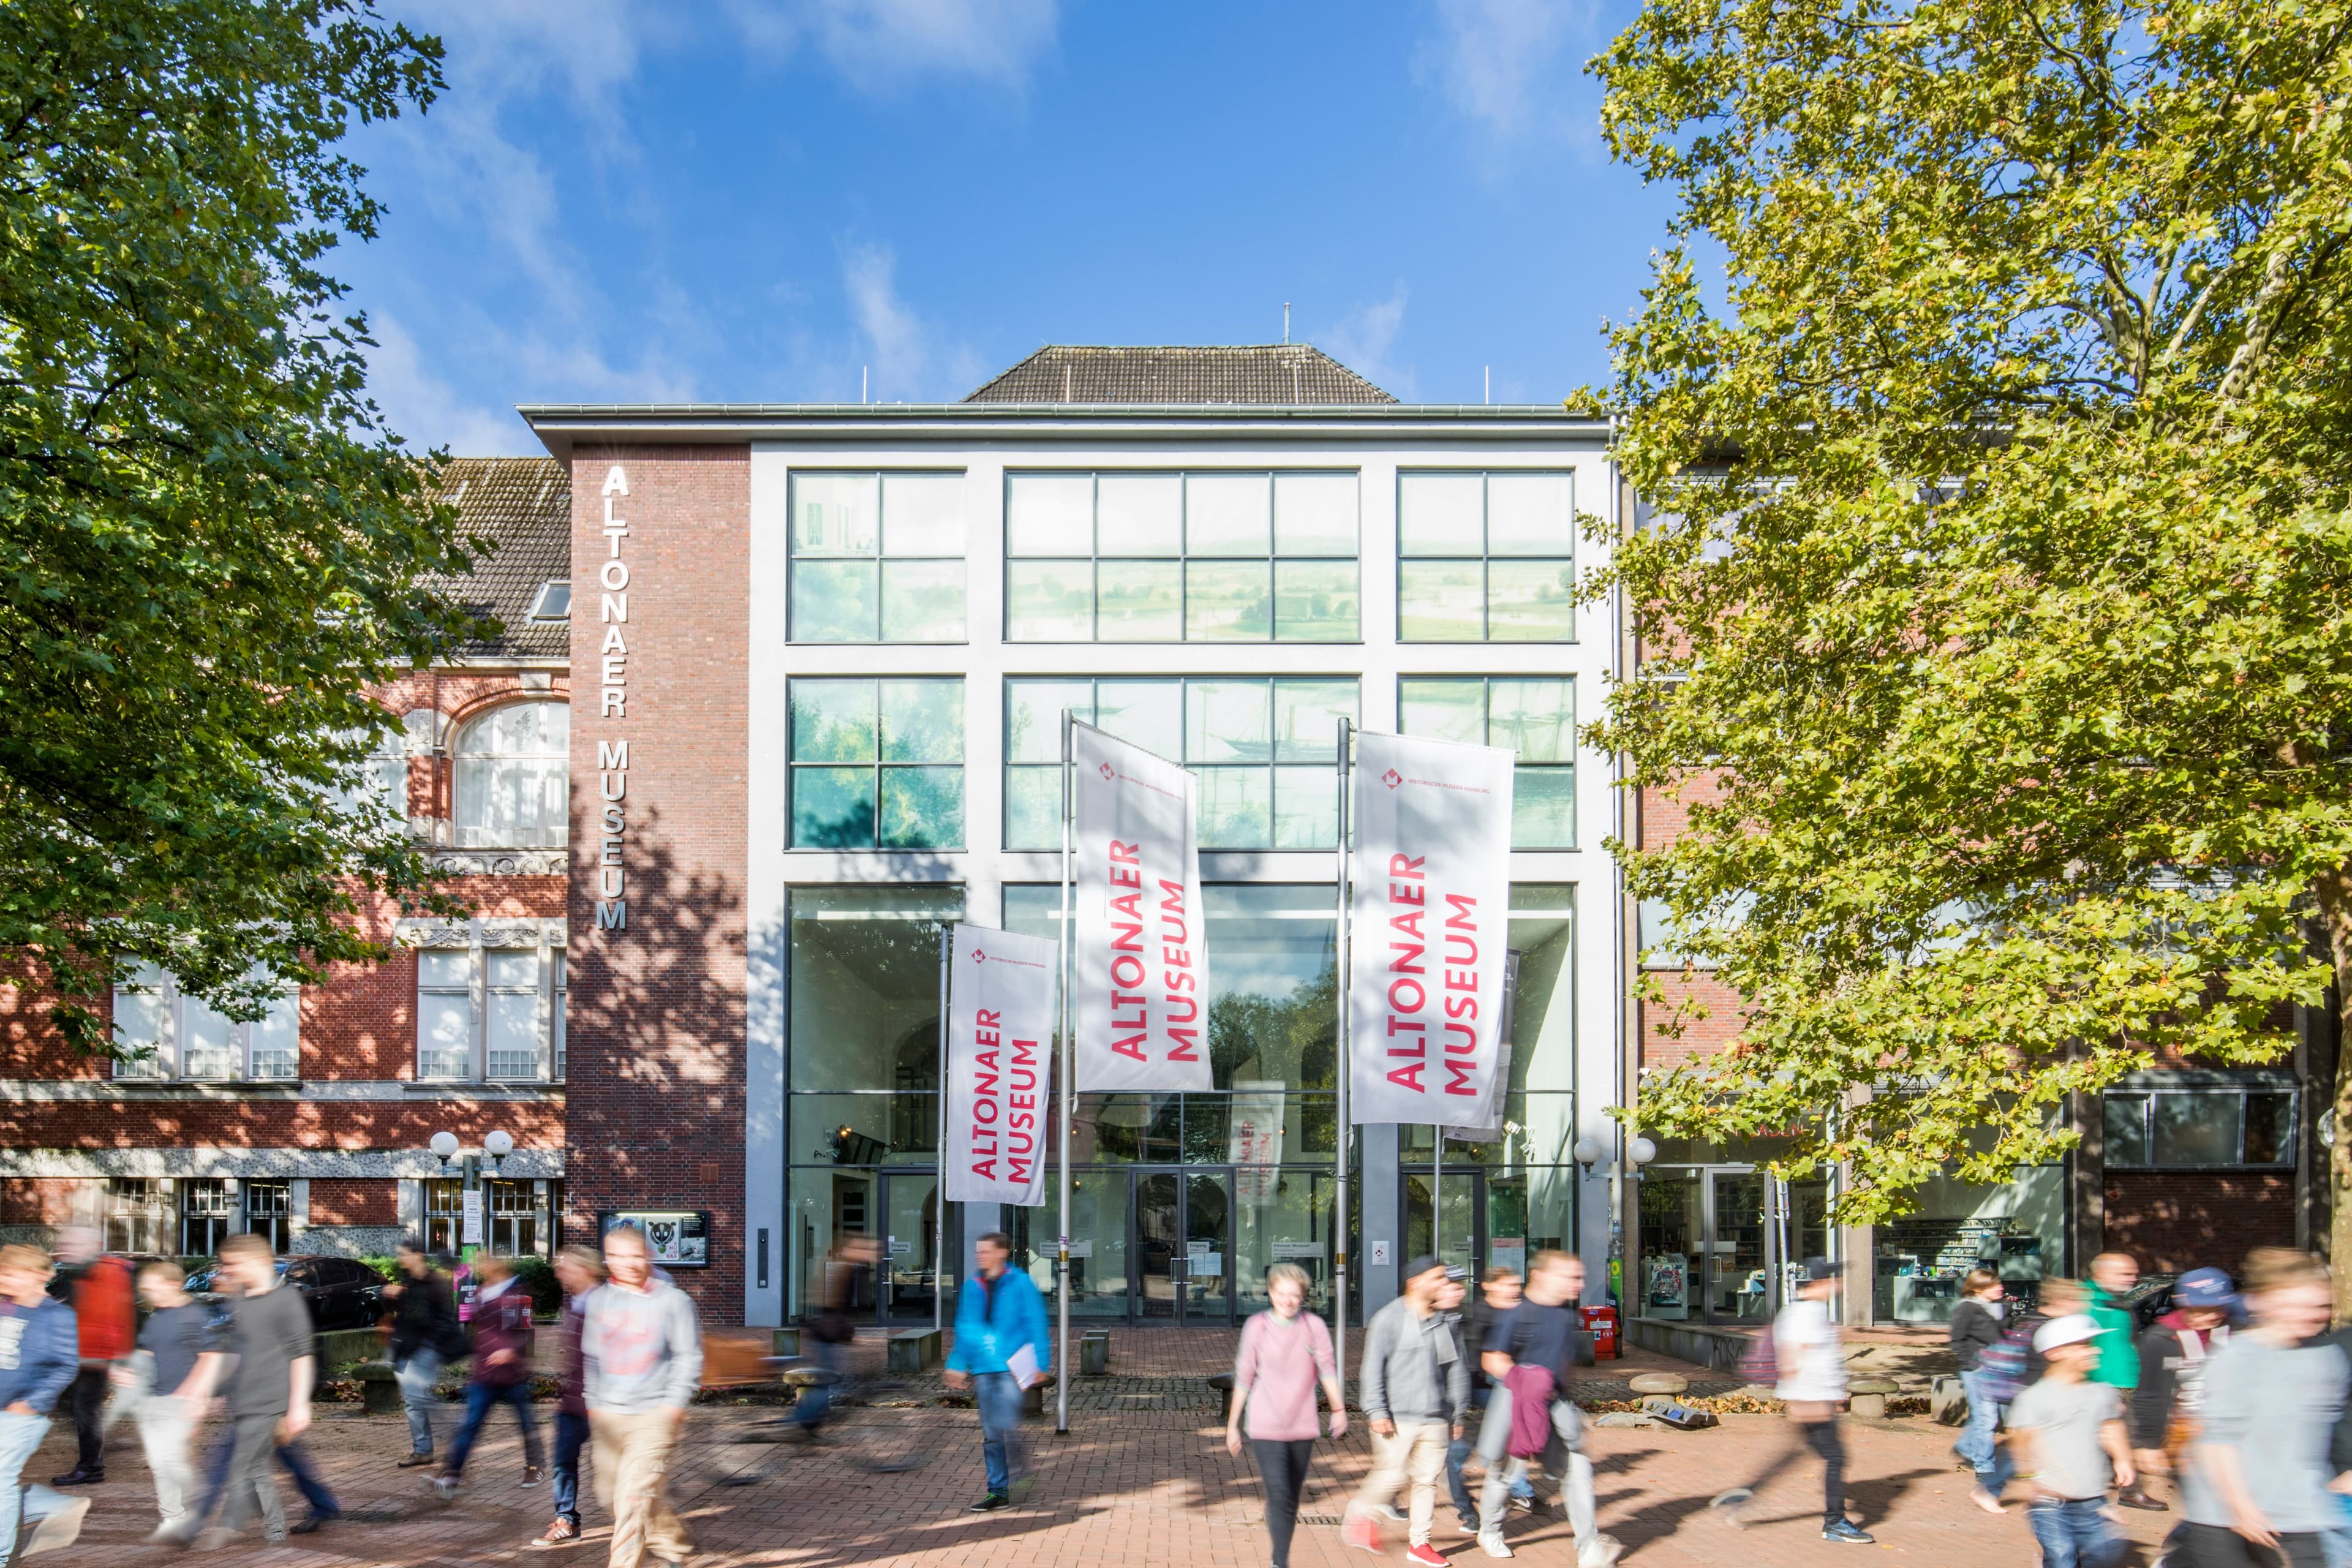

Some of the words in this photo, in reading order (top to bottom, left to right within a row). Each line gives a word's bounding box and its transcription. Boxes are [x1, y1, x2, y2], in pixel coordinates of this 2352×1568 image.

[601, 466, 630, 717] ALTONAER
[597, 740, 628, 930] MUSEUM
[1109, 839, 1147, 1063] ALTONAER
[1158, 879, 1199, 1063] MUSEUM
[1386, 853, 1426, 1094] ALTONAER
[1444, 893, 1479, 1097] MUSEUM
[971, 1009, 1001, 1181] ALTONAER
[1008, 1039, 1038, 1185] MUSEUM
